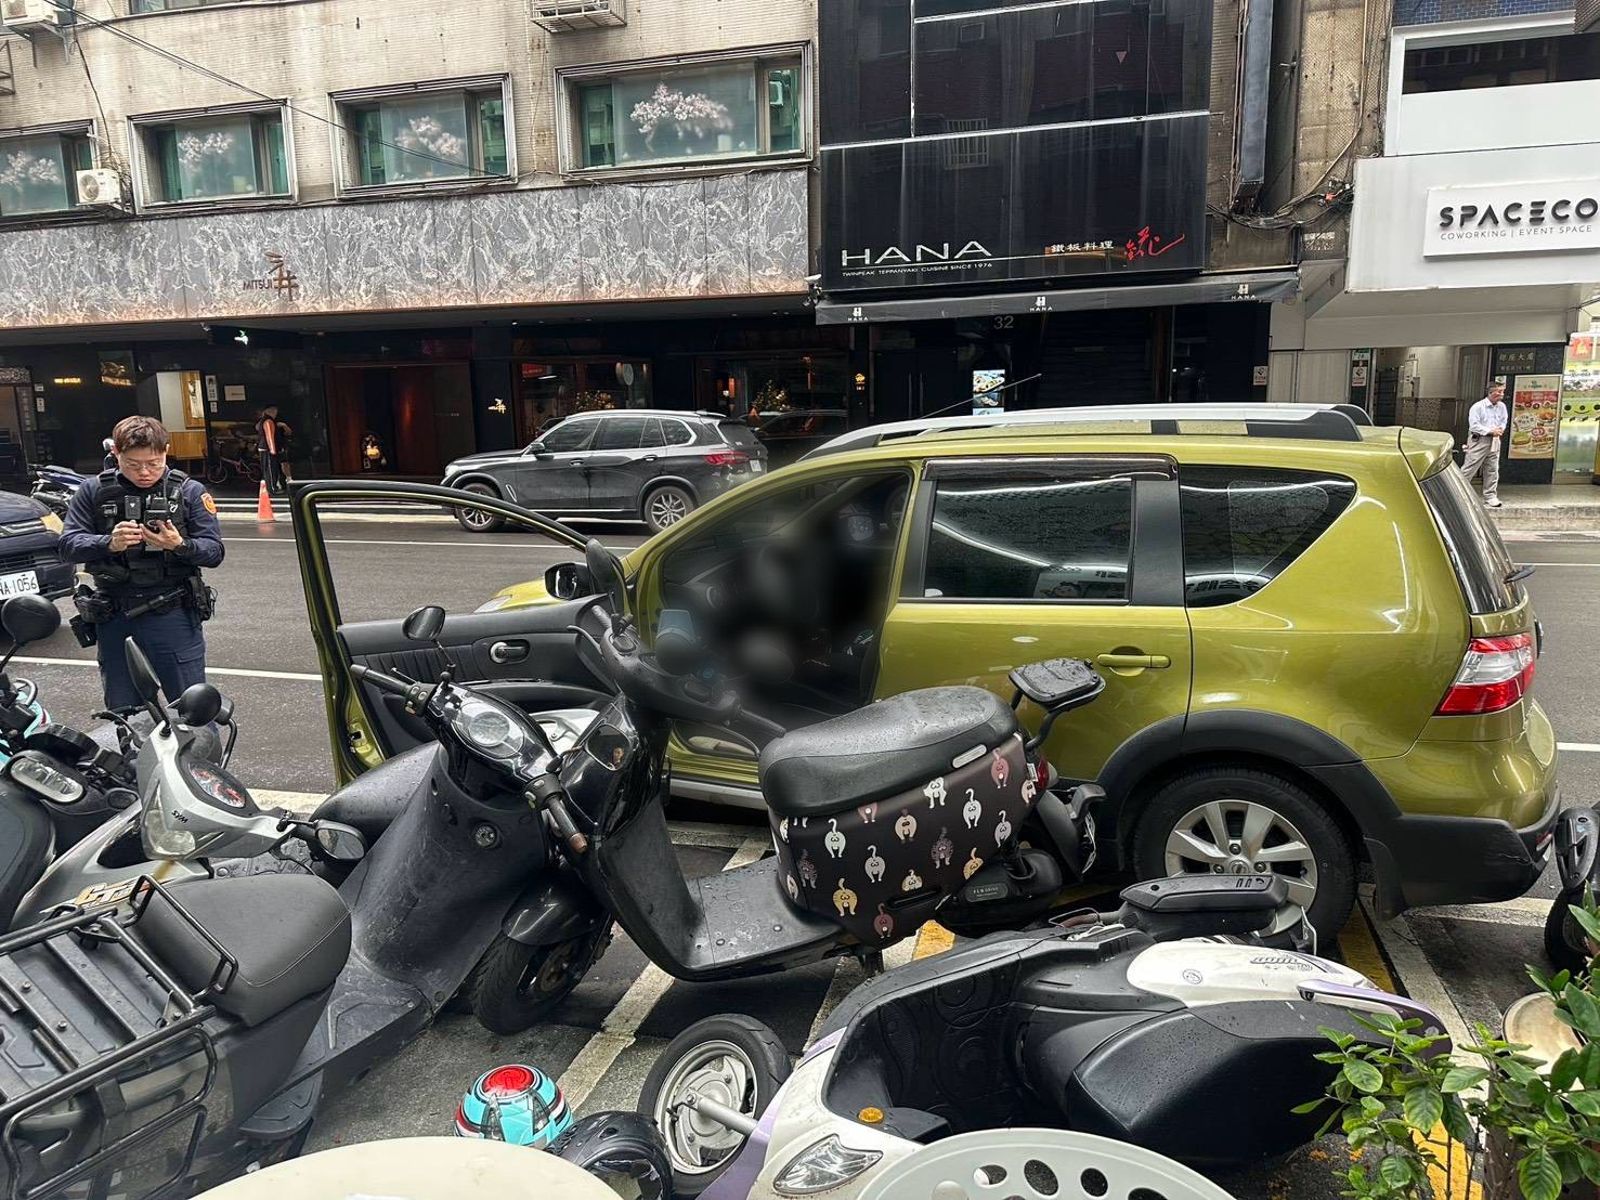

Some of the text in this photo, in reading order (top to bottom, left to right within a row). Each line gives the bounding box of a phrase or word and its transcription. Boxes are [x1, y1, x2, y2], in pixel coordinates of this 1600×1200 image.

[1439, 198, 1599, 228] SPACECO
[1440, 225, 1592, 240] COWORKING EVENT SPACE
[841, 240, 992, 266] HANA
[1051, 240, 1114, 253] 鐵板料理
[842, 269, 875, 277] TWINPEAK
[878, 267, 919, 275] TEPPANYAKI
[242, 279, 273, 290] MITSUI
[993, 315, 1014, 329] 32
[171, 809, 189, 824] SYM
